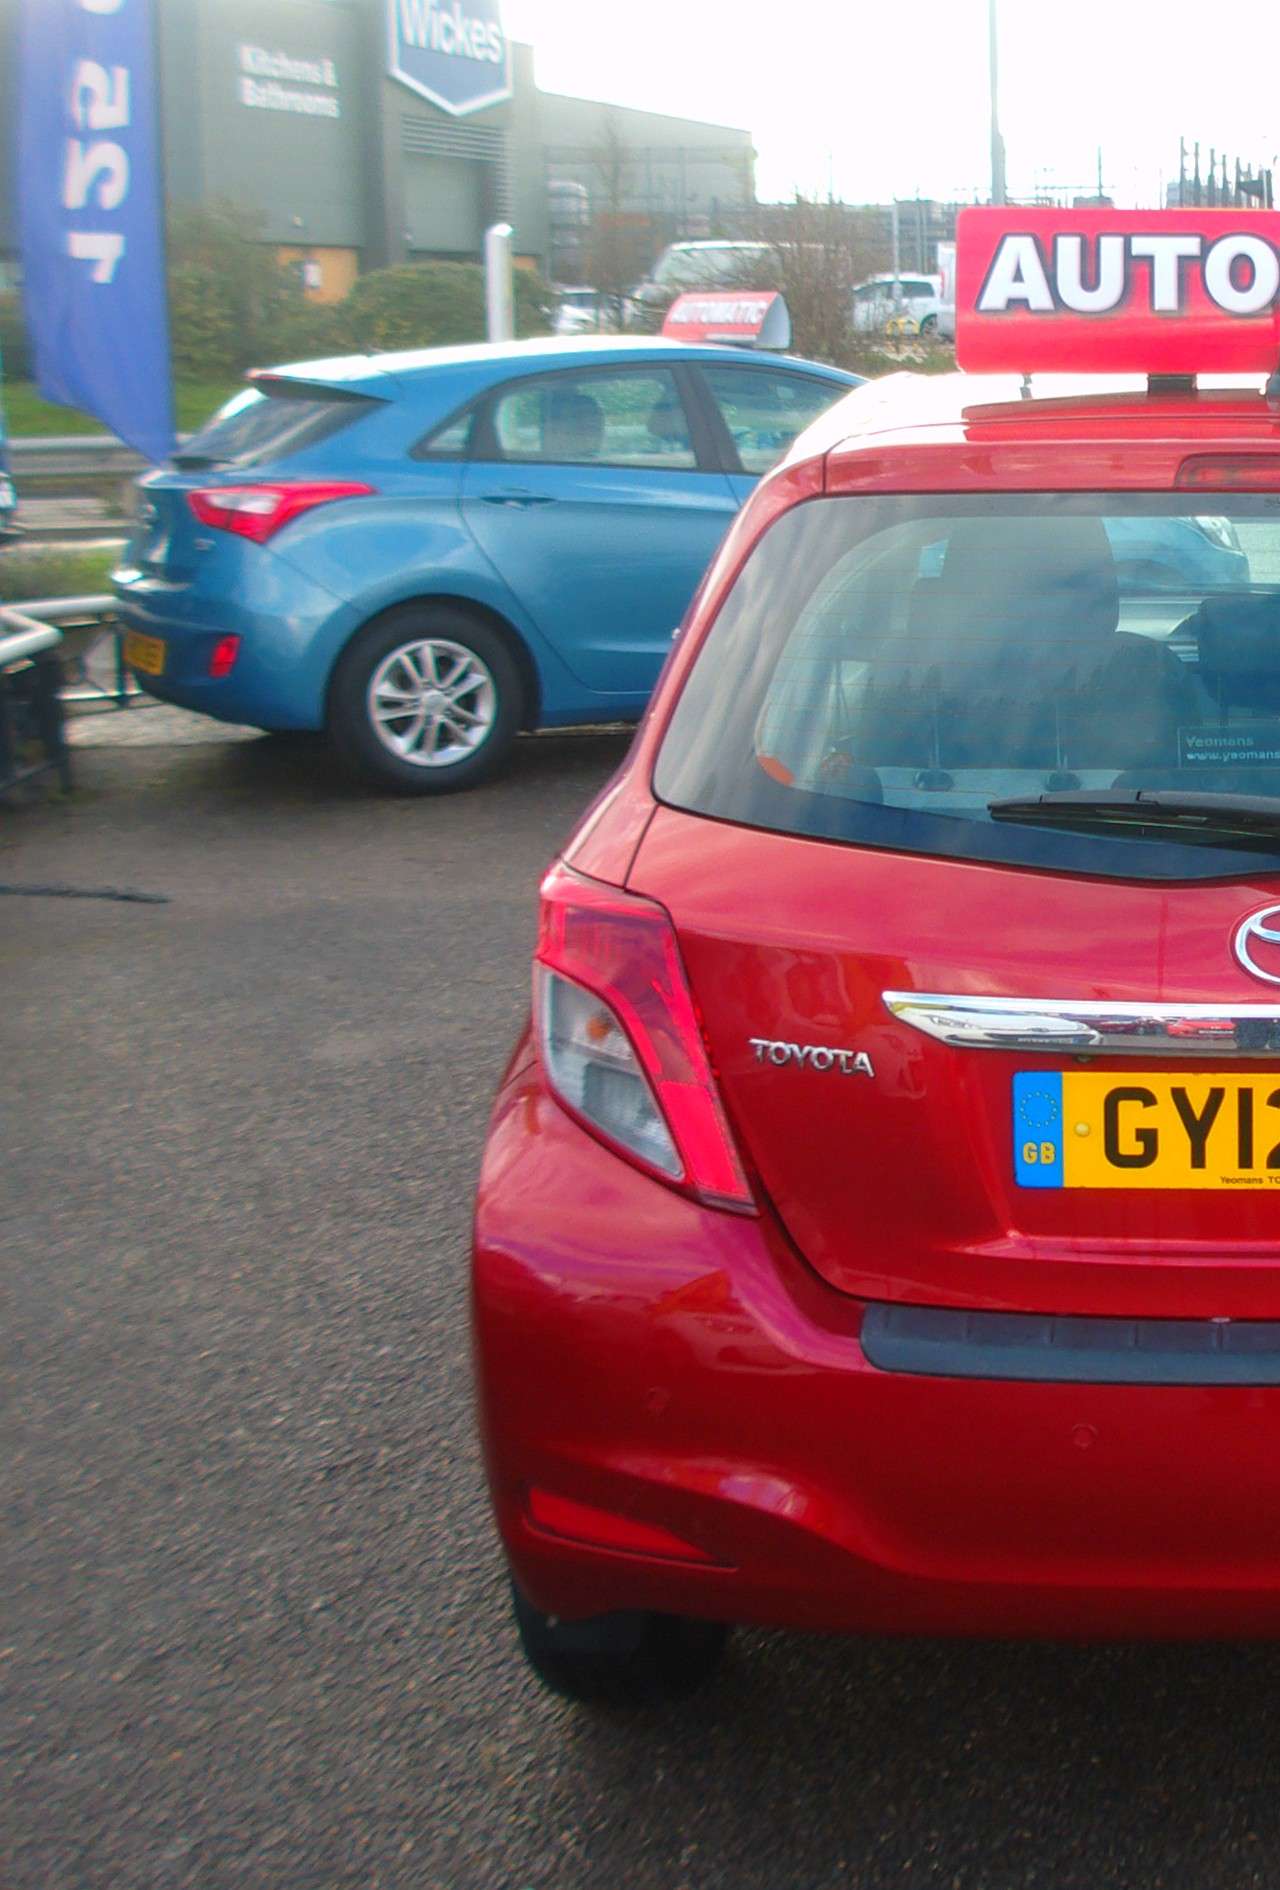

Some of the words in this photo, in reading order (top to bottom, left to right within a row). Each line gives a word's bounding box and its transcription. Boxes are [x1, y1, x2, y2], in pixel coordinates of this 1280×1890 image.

[401, 0, 500, 63] Wickes
[1186, 736, 1254, 748] Yeomans
[749, 1038, 875, 1078] TOYOTA
[1023, 1142, 1056, 1165] GB
[1220, 1175, 1263, 1185] Yeomans
